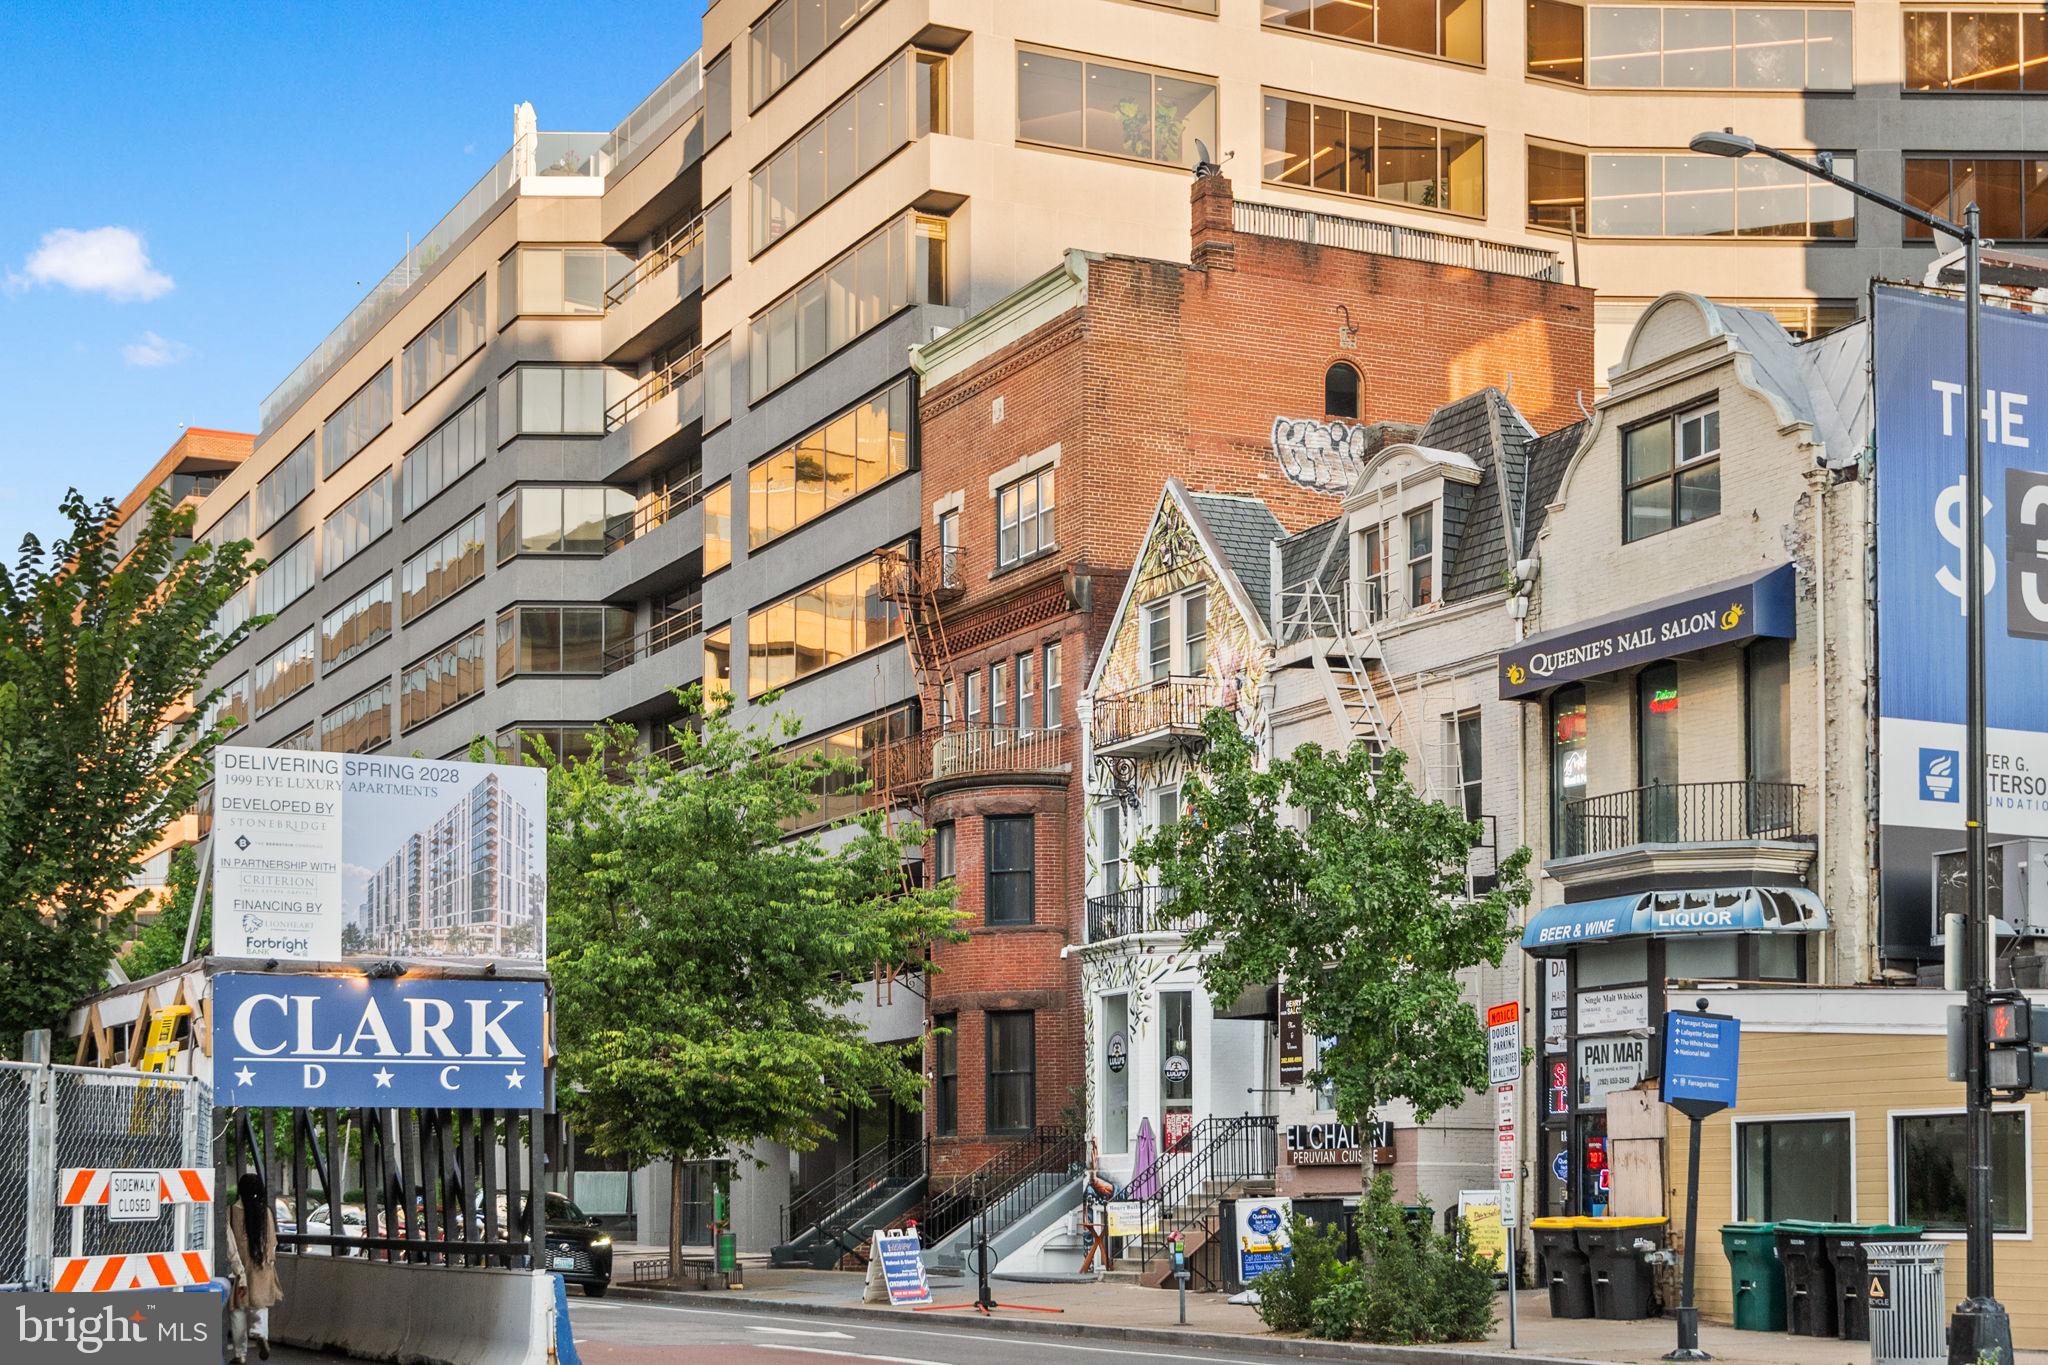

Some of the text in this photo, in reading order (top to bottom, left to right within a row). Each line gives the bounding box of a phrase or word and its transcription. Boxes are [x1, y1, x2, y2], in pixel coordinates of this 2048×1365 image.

[1931, 380, 2029, 448] THE
[1529, 610, 1716, 677] QUEENIE'S NAIL SALON
[224, 754, 459, 783] DELIVERING SPRING 2028
[1985, 753, 2029, 772] TER G.
[225, 774, 438, 798] 1999 EYE LUXURY APARTMENTS
[1989, 773, 2047, 796] TERSO
[222, 797, 335, 814] DEVELOPED BY
[230, 817, 328, 832] STONEBRIDGE
[221, 858, 336, 871] IN PARTNERSHIP WITH
[243, 874, 315, 887] CRITERION
[233, 899, 323, 913] FINANCING BY
[265, 919, 314, 929] LIONHEART
[1658, 912, 1732, 927] LIQUOR
[1539, 918, 1616, 942] BEER & WINE
[246, 936, 308, 953] Forbright
[1584, 991, 1643, 1005] Single Malt Whiskies
[1491, 1009, 1515, 1024] NOTICE
[1681, 1018, 1718, 1029] Farragut Square
[232, 993, 527, 1058] CLARK
[1491, 1024, 1516, 1039] DOUBLE
[1680, 1029, 1718, 1039] Lafayette Square
[1493, 1039, 1515, 1052] PARKING
[1703, 1041, 1719, 1049] House
[1492, 1052, 1517, 1066] PROHIBITED
[1585, 1042, 1643, 1066] PAN MAR
[1699, 1050, 1710, 1058] Mall
[303, 1064, 461, 1090] D C
[1688, 1080, 1720, 1089] Farragut West
[1286, 1120, 1387, 1151] EL CHALN
[1293, 1149, 1379, 1164] PERUVIAN CUISE
[114, 1178, 156, 1192] SIDEWALK
[118, 1198, 151, 1212] CLOSED
